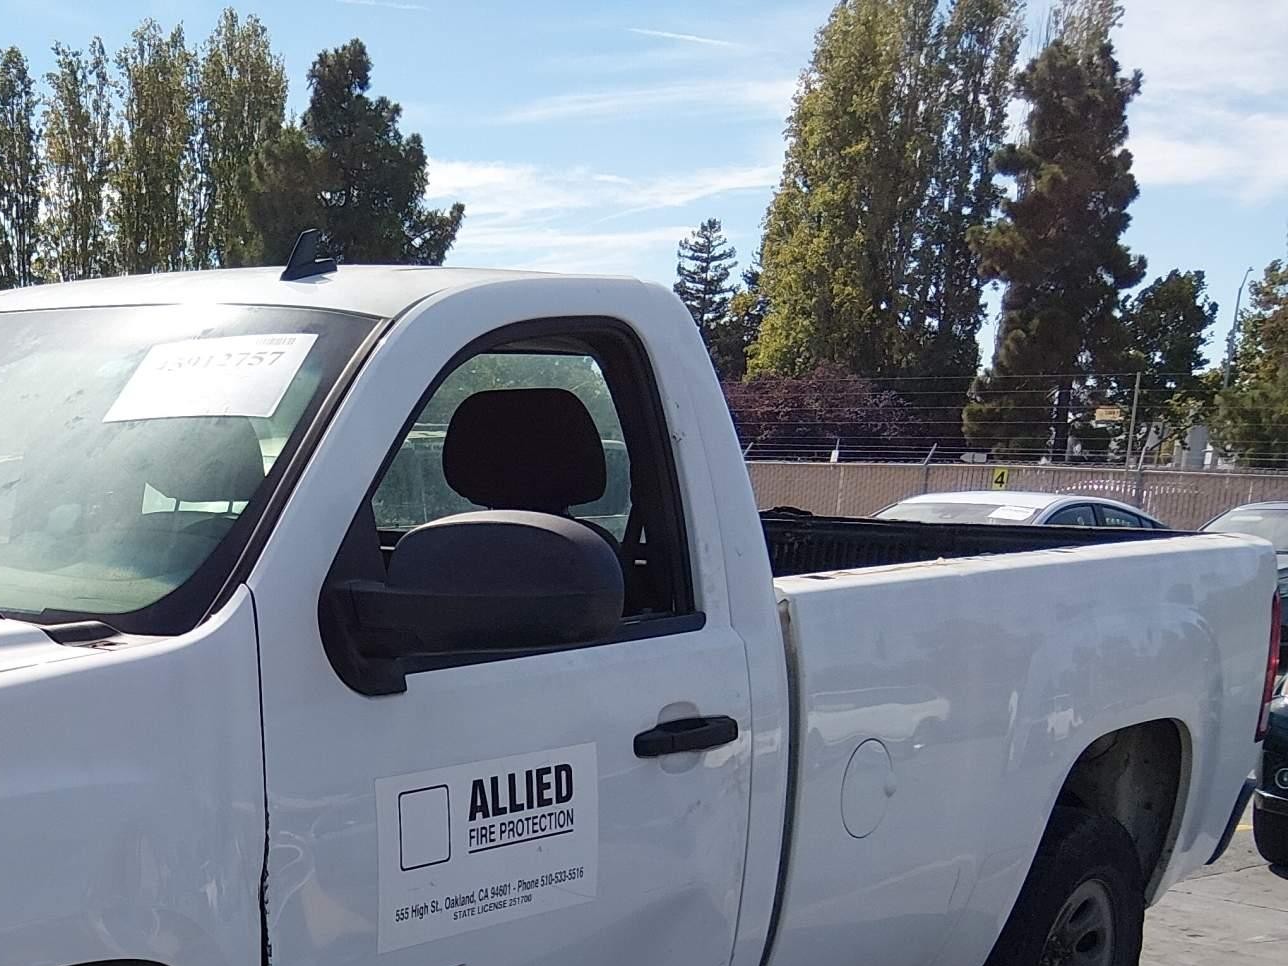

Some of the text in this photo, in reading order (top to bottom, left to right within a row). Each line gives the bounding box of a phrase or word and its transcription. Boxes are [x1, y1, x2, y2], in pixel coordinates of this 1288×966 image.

[994, 470, 1006, 488] 4
[468, 763, 574, 822] ALLIED
[468, 807, 574, 848] FIRE PROTECTION
[394, 906, 410, 923] 555
[411, 902, 429, 920] High
[478, 887, 490, 902] CA
[490, 882, 511, 899] 94601
[517, 878, 540, 893] Phone
[453, 907, 476, 921] STATE
[477, 899, 508, 915] LICENSE
